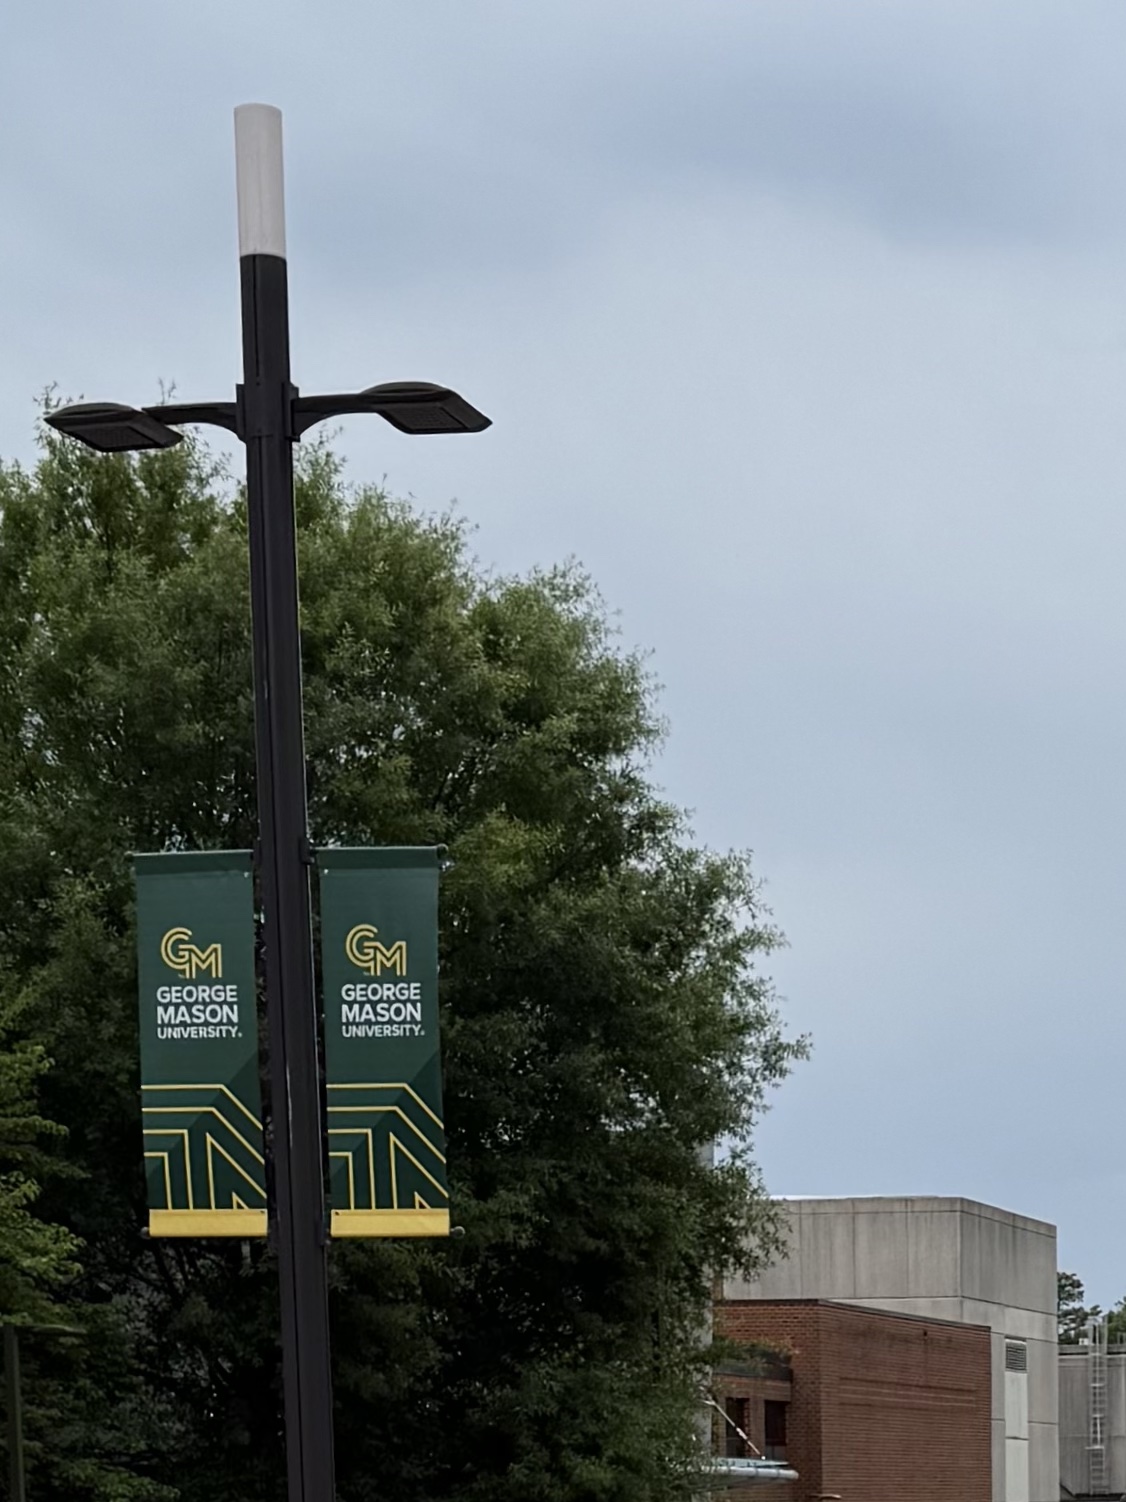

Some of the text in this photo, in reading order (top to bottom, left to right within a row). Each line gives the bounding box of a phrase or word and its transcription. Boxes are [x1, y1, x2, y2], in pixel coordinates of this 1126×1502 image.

[160, 927, 222, 979] GM
[346, 923, 406, 976] GM
[156, 985, 238, 1003] GEORGE
[341, 983, 421, 1001] GEORGE
[157, 1004, 238, 1025] MASON
[342, 1002, 421, 1023] MASON
